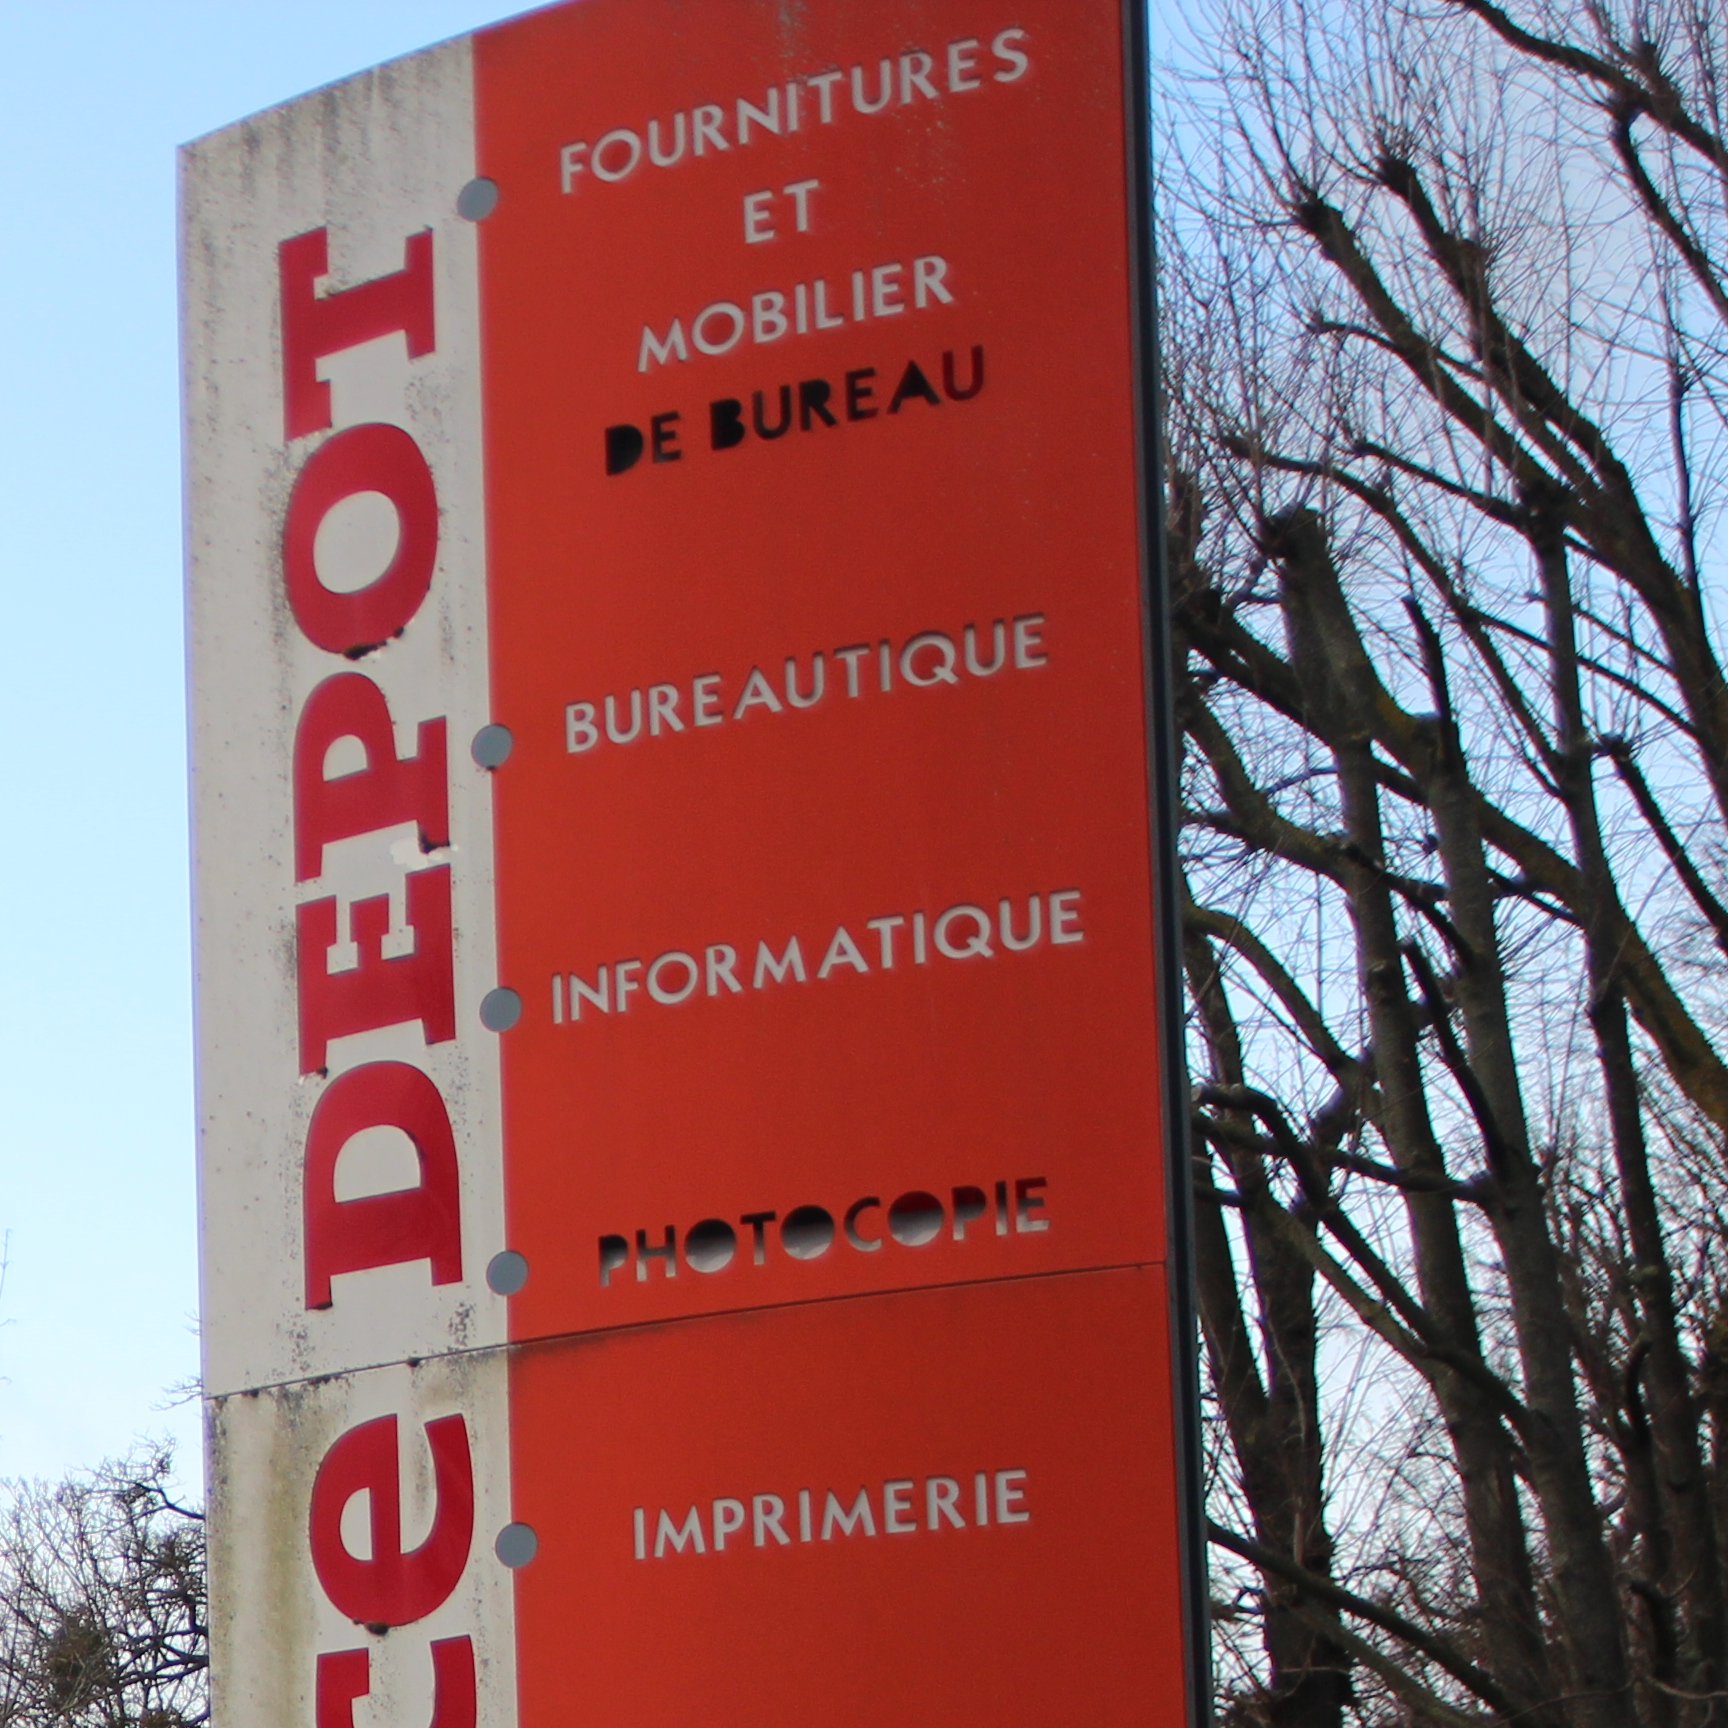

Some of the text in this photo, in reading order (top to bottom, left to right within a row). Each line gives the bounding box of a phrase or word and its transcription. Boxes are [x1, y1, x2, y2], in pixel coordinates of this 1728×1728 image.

[560, 28, 1029, 195] FOURNITURES
[744, 179, 819, 244] ET
[637, 255, 955, 373] MOBILIER
[605, 344, 985, 476] DE BUREAU
[565, 613, 1048, 754] BUREAUTIQUE
[279, 226, 462, 1310] DEPOT
[552, 889, 1085, 1025] INFORMATIQUE
[598, 1177, 1051, 1287] PHOTOCOPIE
[633, 1469, 1031, 1560] IMPRIMERIE
